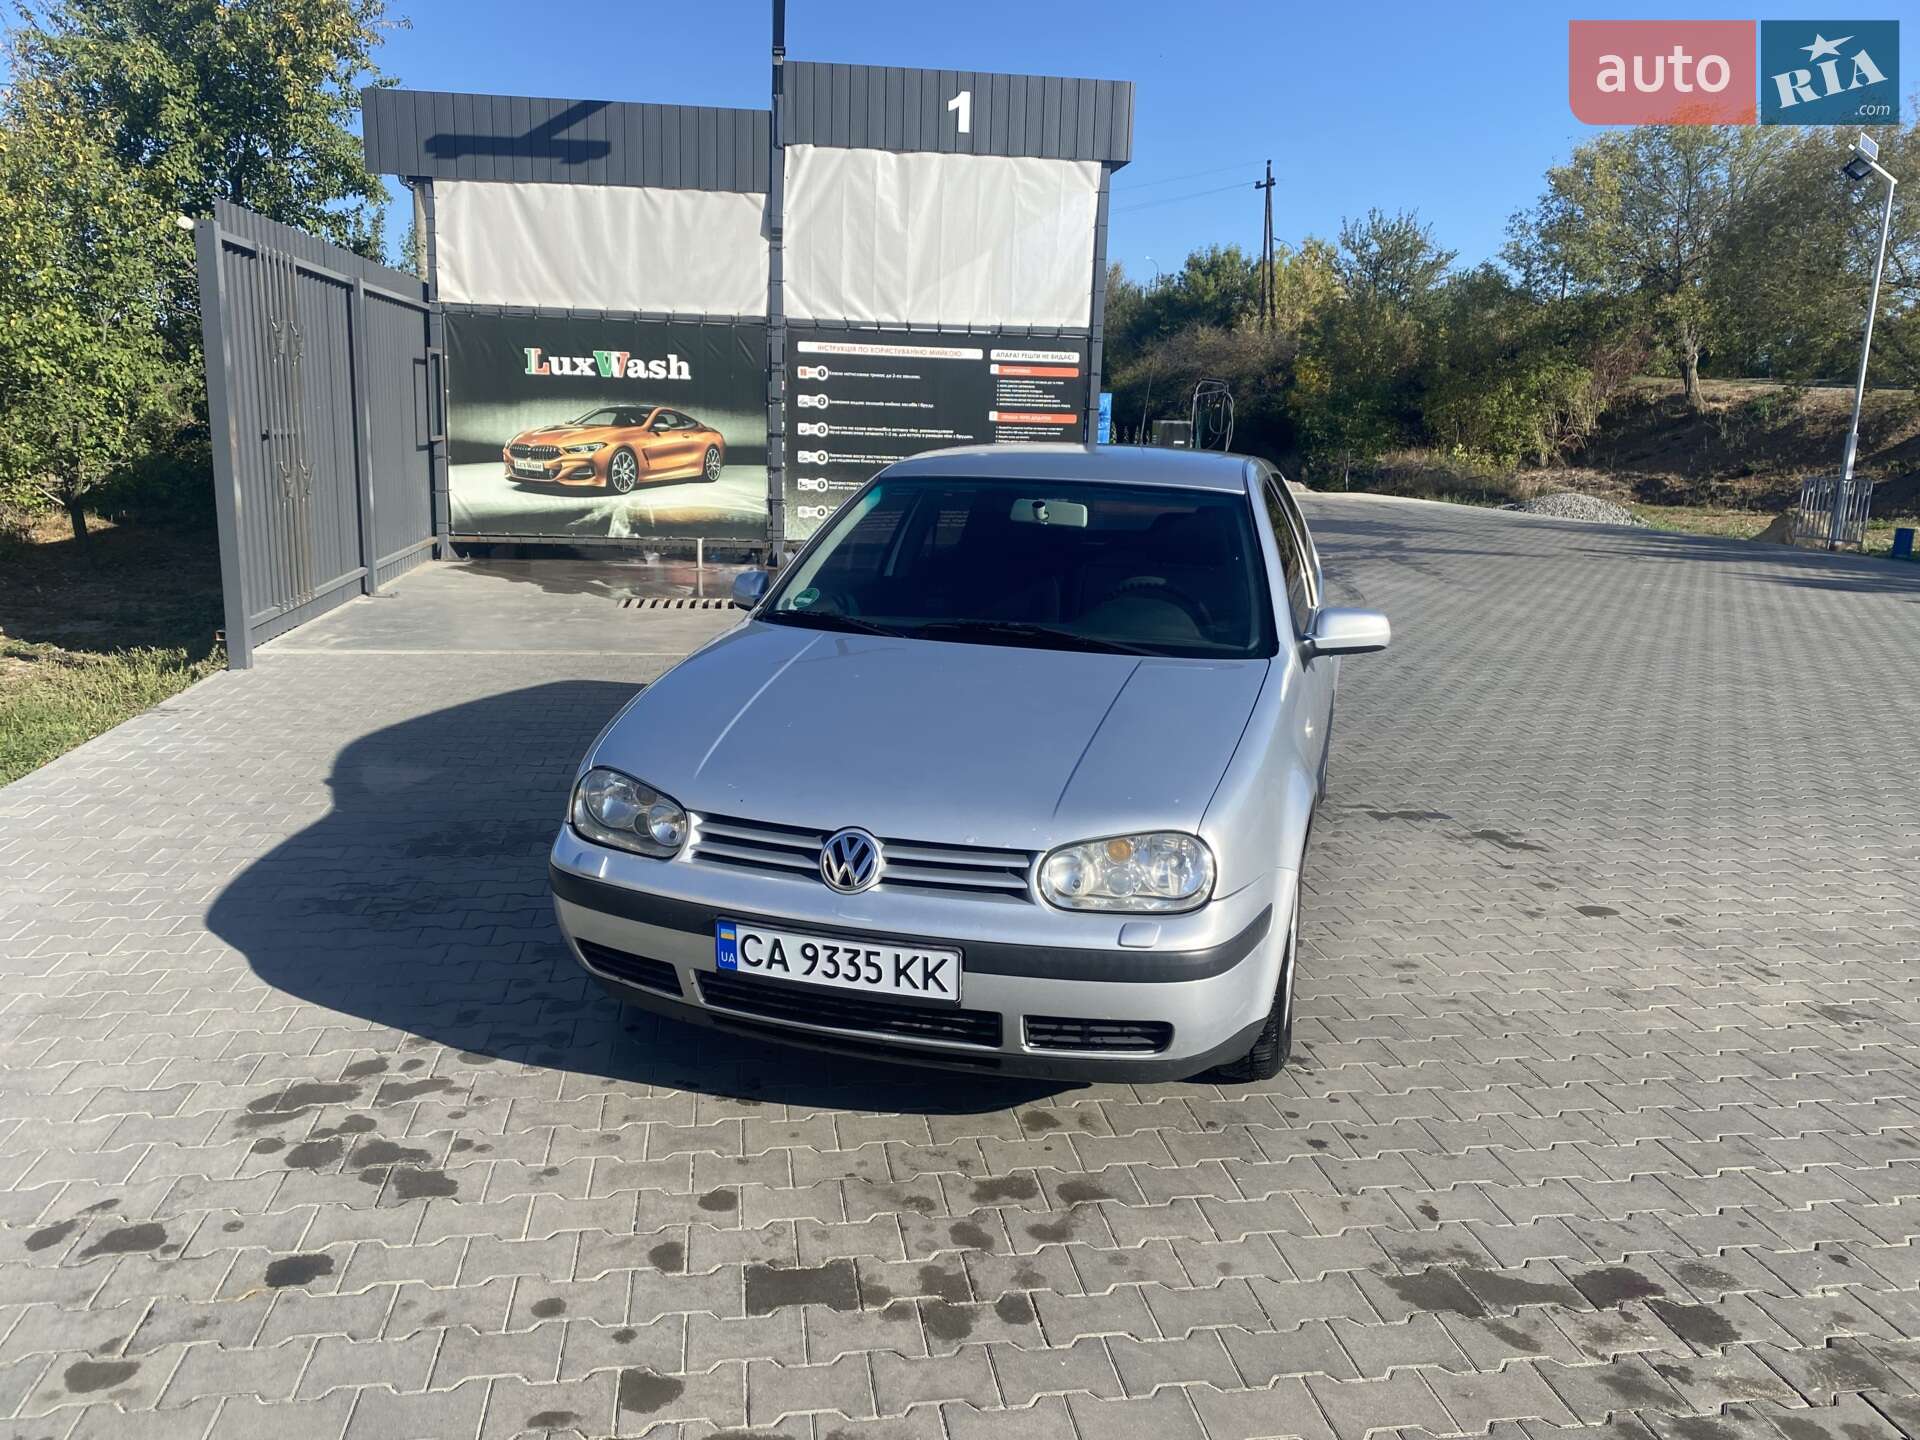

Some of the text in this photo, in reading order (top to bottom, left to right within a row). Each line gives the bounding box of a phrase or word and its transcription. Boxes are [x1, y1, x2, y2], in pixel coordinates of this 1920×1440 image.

[948, 91, 971, 133] 1
[524, 347, 692, 381] LuxWash
[721, 952, 736, 965] UA
[740, 933, 949, 993] CA 9335 KK
